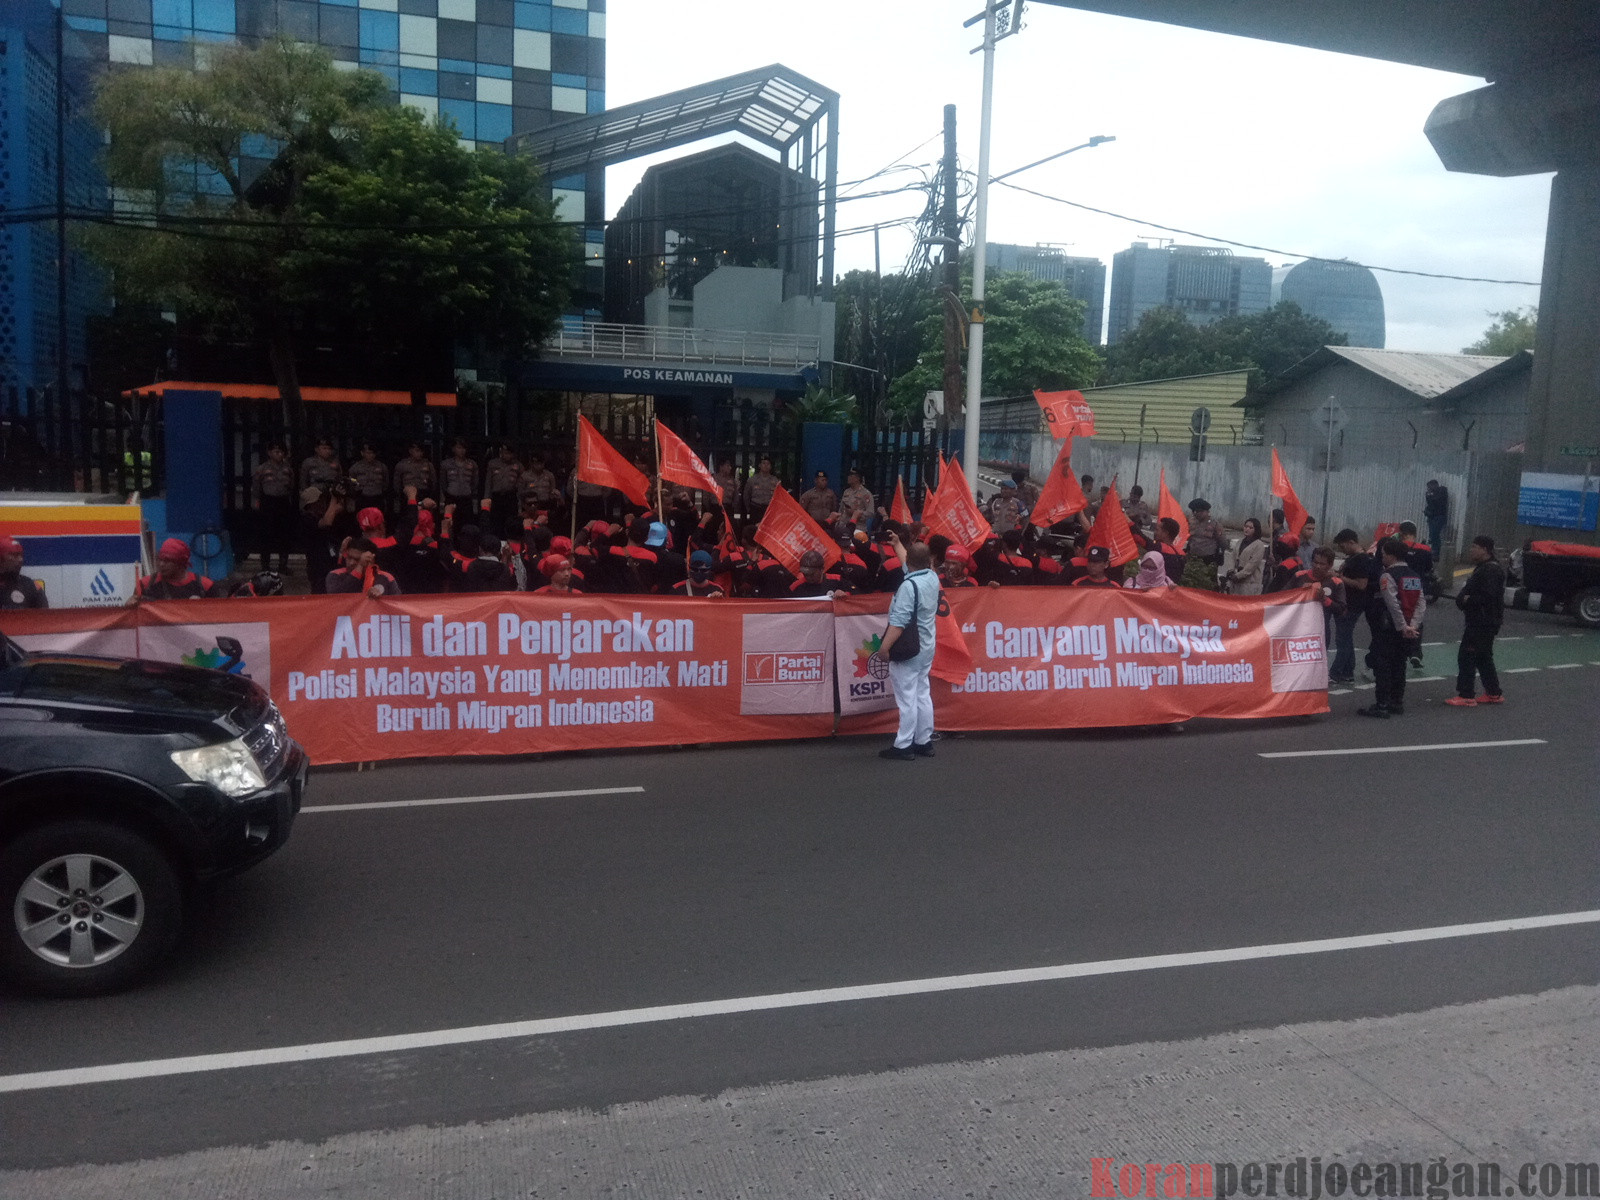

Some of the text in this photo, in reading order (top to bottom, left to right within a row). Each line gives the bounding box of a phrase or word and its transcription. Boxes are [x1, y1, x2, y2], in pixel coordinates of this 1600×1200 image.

[623, 368, 733, 384] POS KEAMANAN
[330, 612, 694, 661] Adili dan Penjarakan
[985, 620, 1108, 663] Ganyang
[1113, 617, 1226, 659] Malaysia
[778, 655, 821, 668] Partai
[778, 667, 821, 681] Buruh
[1053, 663, 1112, 690] Buruh
[1115, 661, 1178, 691] Migran
[1181, 659, 1254, 686] Indonesia
[288, 659, 728, 702] Polisi Malaysia Yang Menembak Mati
[850, 680, 886, 697] KSPI
[377, 695, 654, 734] Buruh Migran Indonesia
